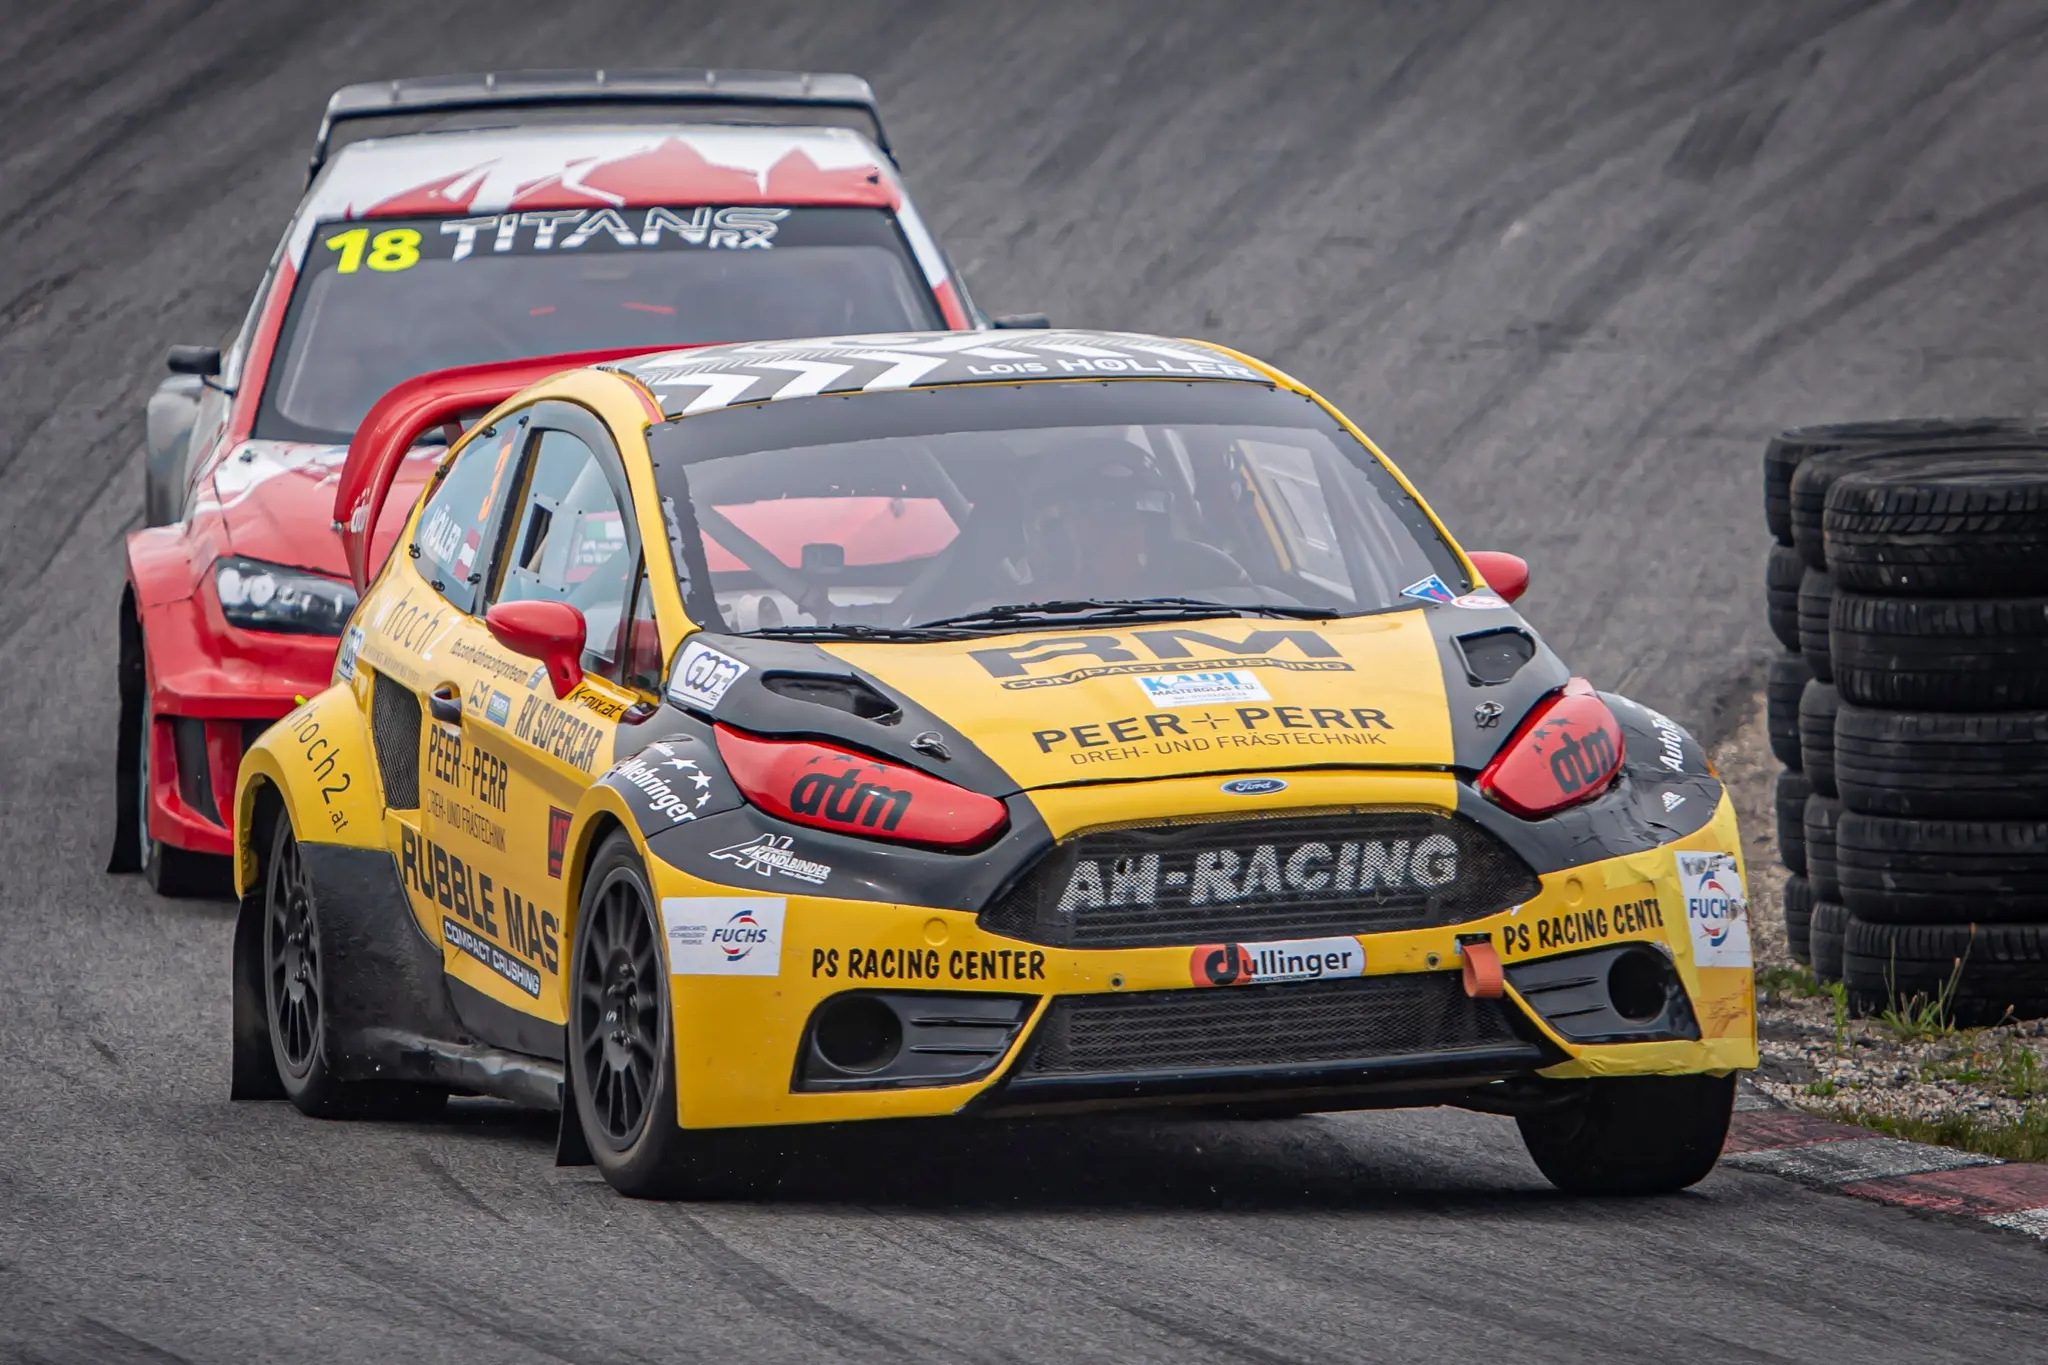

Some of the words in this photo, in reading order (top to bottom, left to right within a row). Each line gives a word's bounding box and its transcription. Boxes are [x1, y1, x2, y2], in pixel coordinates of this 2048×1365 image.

[326, 228, 423, 273] 18
[440, 207, 791, 262] TITANS
[709, 229, 775, 250] RX
[967, 362, 1048, 375] LOIS
[966, 629, 1343, 679] RM
[1008, 664, 1168, 689] COMPACT
[1175, 659, 1347, 671] CRUSHING
[569, 687, 625, 719] K-pix.at
[533, 702, 604, 774] SUPERCAR
[1032, 713, 1188, 754] PEER
[1234, 706, 1395, 731] PERR
[1070, 746, 1149, 765] DREH-
[1155, 737, 1210, 755] UND
[1218, 731, 1388, 749] FRÄSTECHNIK
[428, 723, 462, 788] PEER
[471, 746, 508, 812] PERR
[613, 758, 698, 823] Mehringer
[446, 799, 461, 829] UND
[462, 803, 507, 854] FRÄSTECHNIK
[1056, 833, 1459, 912] AH-RACING
[401, 823, 499, 939] RUBBLE
[503, 887, 560, 976] MAS
[711, 928, 768, 943] FUCHS
[1503, 923, 1531, 955] PS
[1537, 908, 1608, 949] RACING
[444, 920, 491, 964] COMPACT
[492, 949, 540, 995] CRUSHING
[812, 948, 839, 979] PS
[848, 948, 940, 980] RACING
[949, 949, 1046, 981] CENTER
[1205, 942, 1352, 986] dullinger
